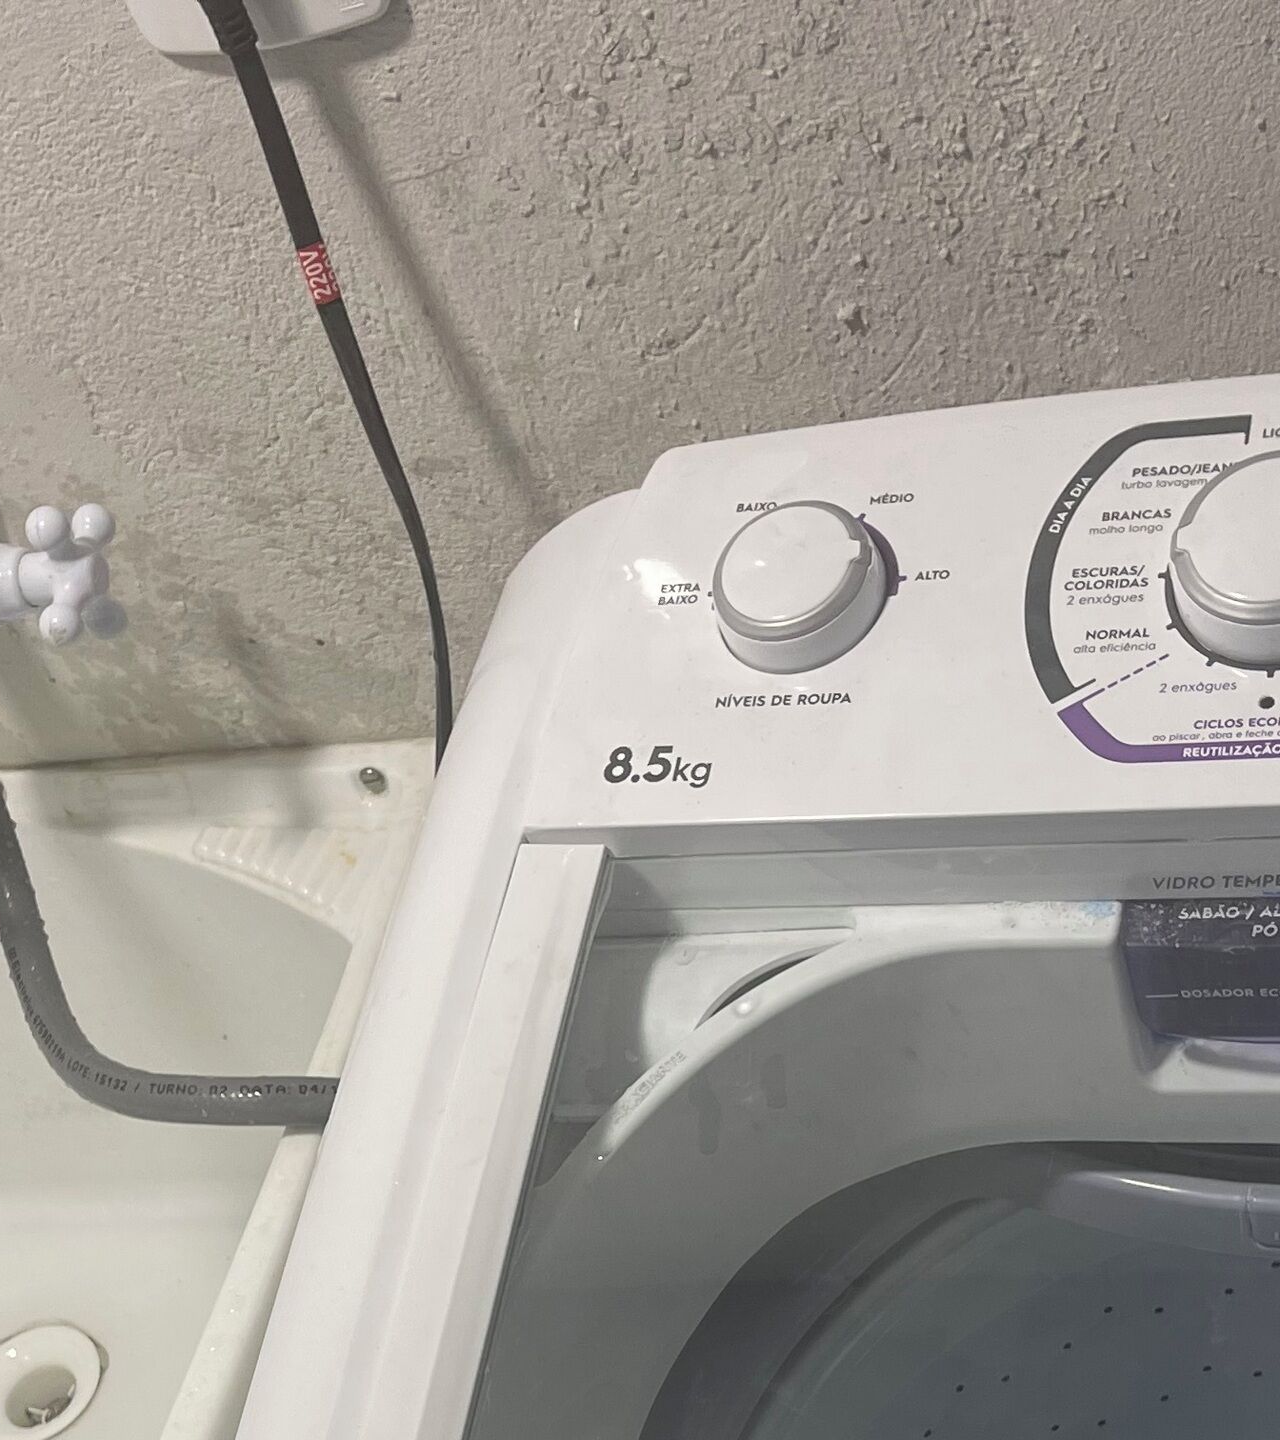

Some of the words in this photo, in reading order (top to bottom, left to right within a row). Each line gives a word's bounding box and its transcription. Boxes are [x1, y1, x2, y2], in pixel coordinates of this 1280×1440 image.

[300, 250, 332, 300] 220V
[1132, 461, 1241, 478] PESADO/JEAN
[1069, 477, 1093, 498] DIA
[1121, 479, 1153, 490] turbo
[1156, 476, 1209, 490] lavagem
[869, 492, 915, 506] MÉDIO
[1063, 500, 1076, 510] A
[735, 501, 778, 513] BAIXO
[1048, 511, 1069, 534] DIA
[1101, 508, 1173, 522] BRANCAS
[1088, 525, 1126, 536] molho
[1128, 523, 1164, 535] longo
[914, 568, 951, 582] ALTO
[1071, 564, 1146, 579] ESCURAS/
[659, 582, 701, 594] EXTRA
[1064, 577, 1150, 592] COLORIDAS
[656, 594, 699, 606] BAIXO
[1066, 595, 1076, 606] 2
[1078, 592, 1145, 607] enxágues
[1085, 627, 1151, 641] NORMAL
[1073, 644, 1097, 655] alta
[1099, 641, 1157, 654] eficiência
[1158, 683, 1168, 694] 2
[1170, 680, 1238, 695] enxágues
[715, 692, 767, 709] NÍVEIS
[771, 694, 791, 707] DE
[797, 691, 852, 707] ROUPA
[1193, 718, 1245, 731] CICLOS
[1152, 734, 1166, 742] ao
[1208, 729, 1233, 740] abra
[1245, 727, 1275, 739] feche
[603, 744, 713, 789] 8.5kg
[1152, 874, 1216, 891] VIDRO
[1178, 904, 1240, 920] SABÃO
[1251, 921, 1279, 938] PÓ
[1180, 986, 1255, 999] DOSADOR
